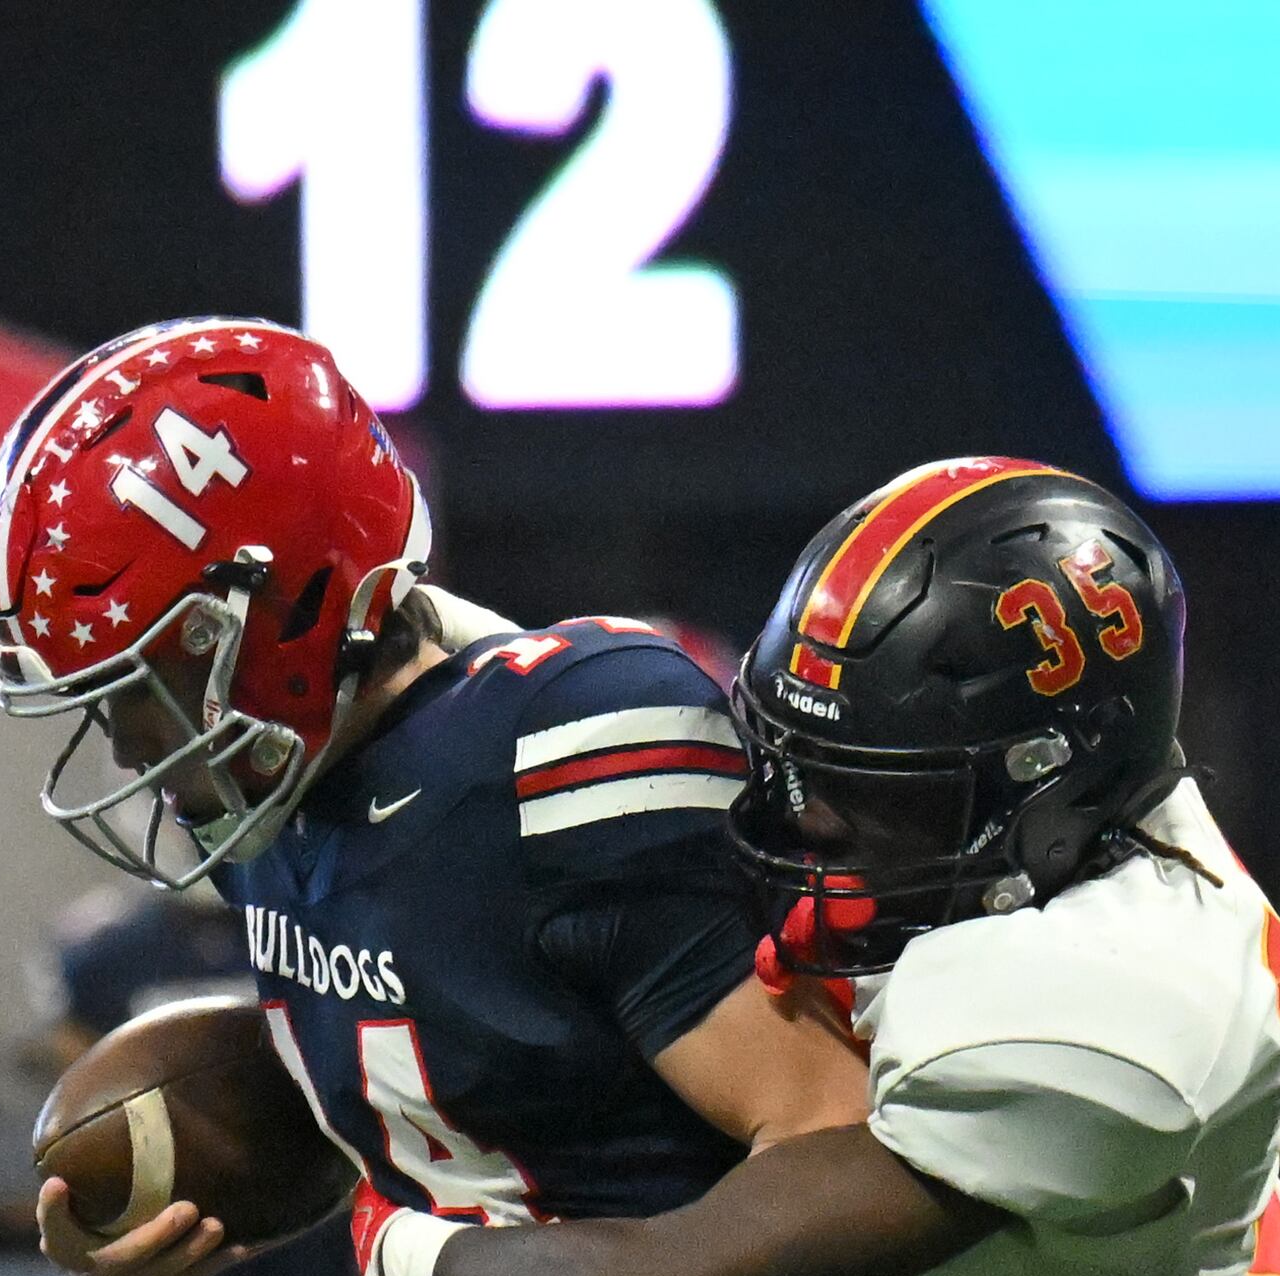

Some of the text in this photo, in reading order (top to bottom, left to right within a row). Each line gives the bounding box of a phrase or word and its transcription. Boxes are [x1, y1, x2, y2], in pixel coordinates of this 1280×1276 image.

[218, 0, 740, 411] 12
[109, 405, 253, 553] 14
[995, 537, 1143, 697] 35
